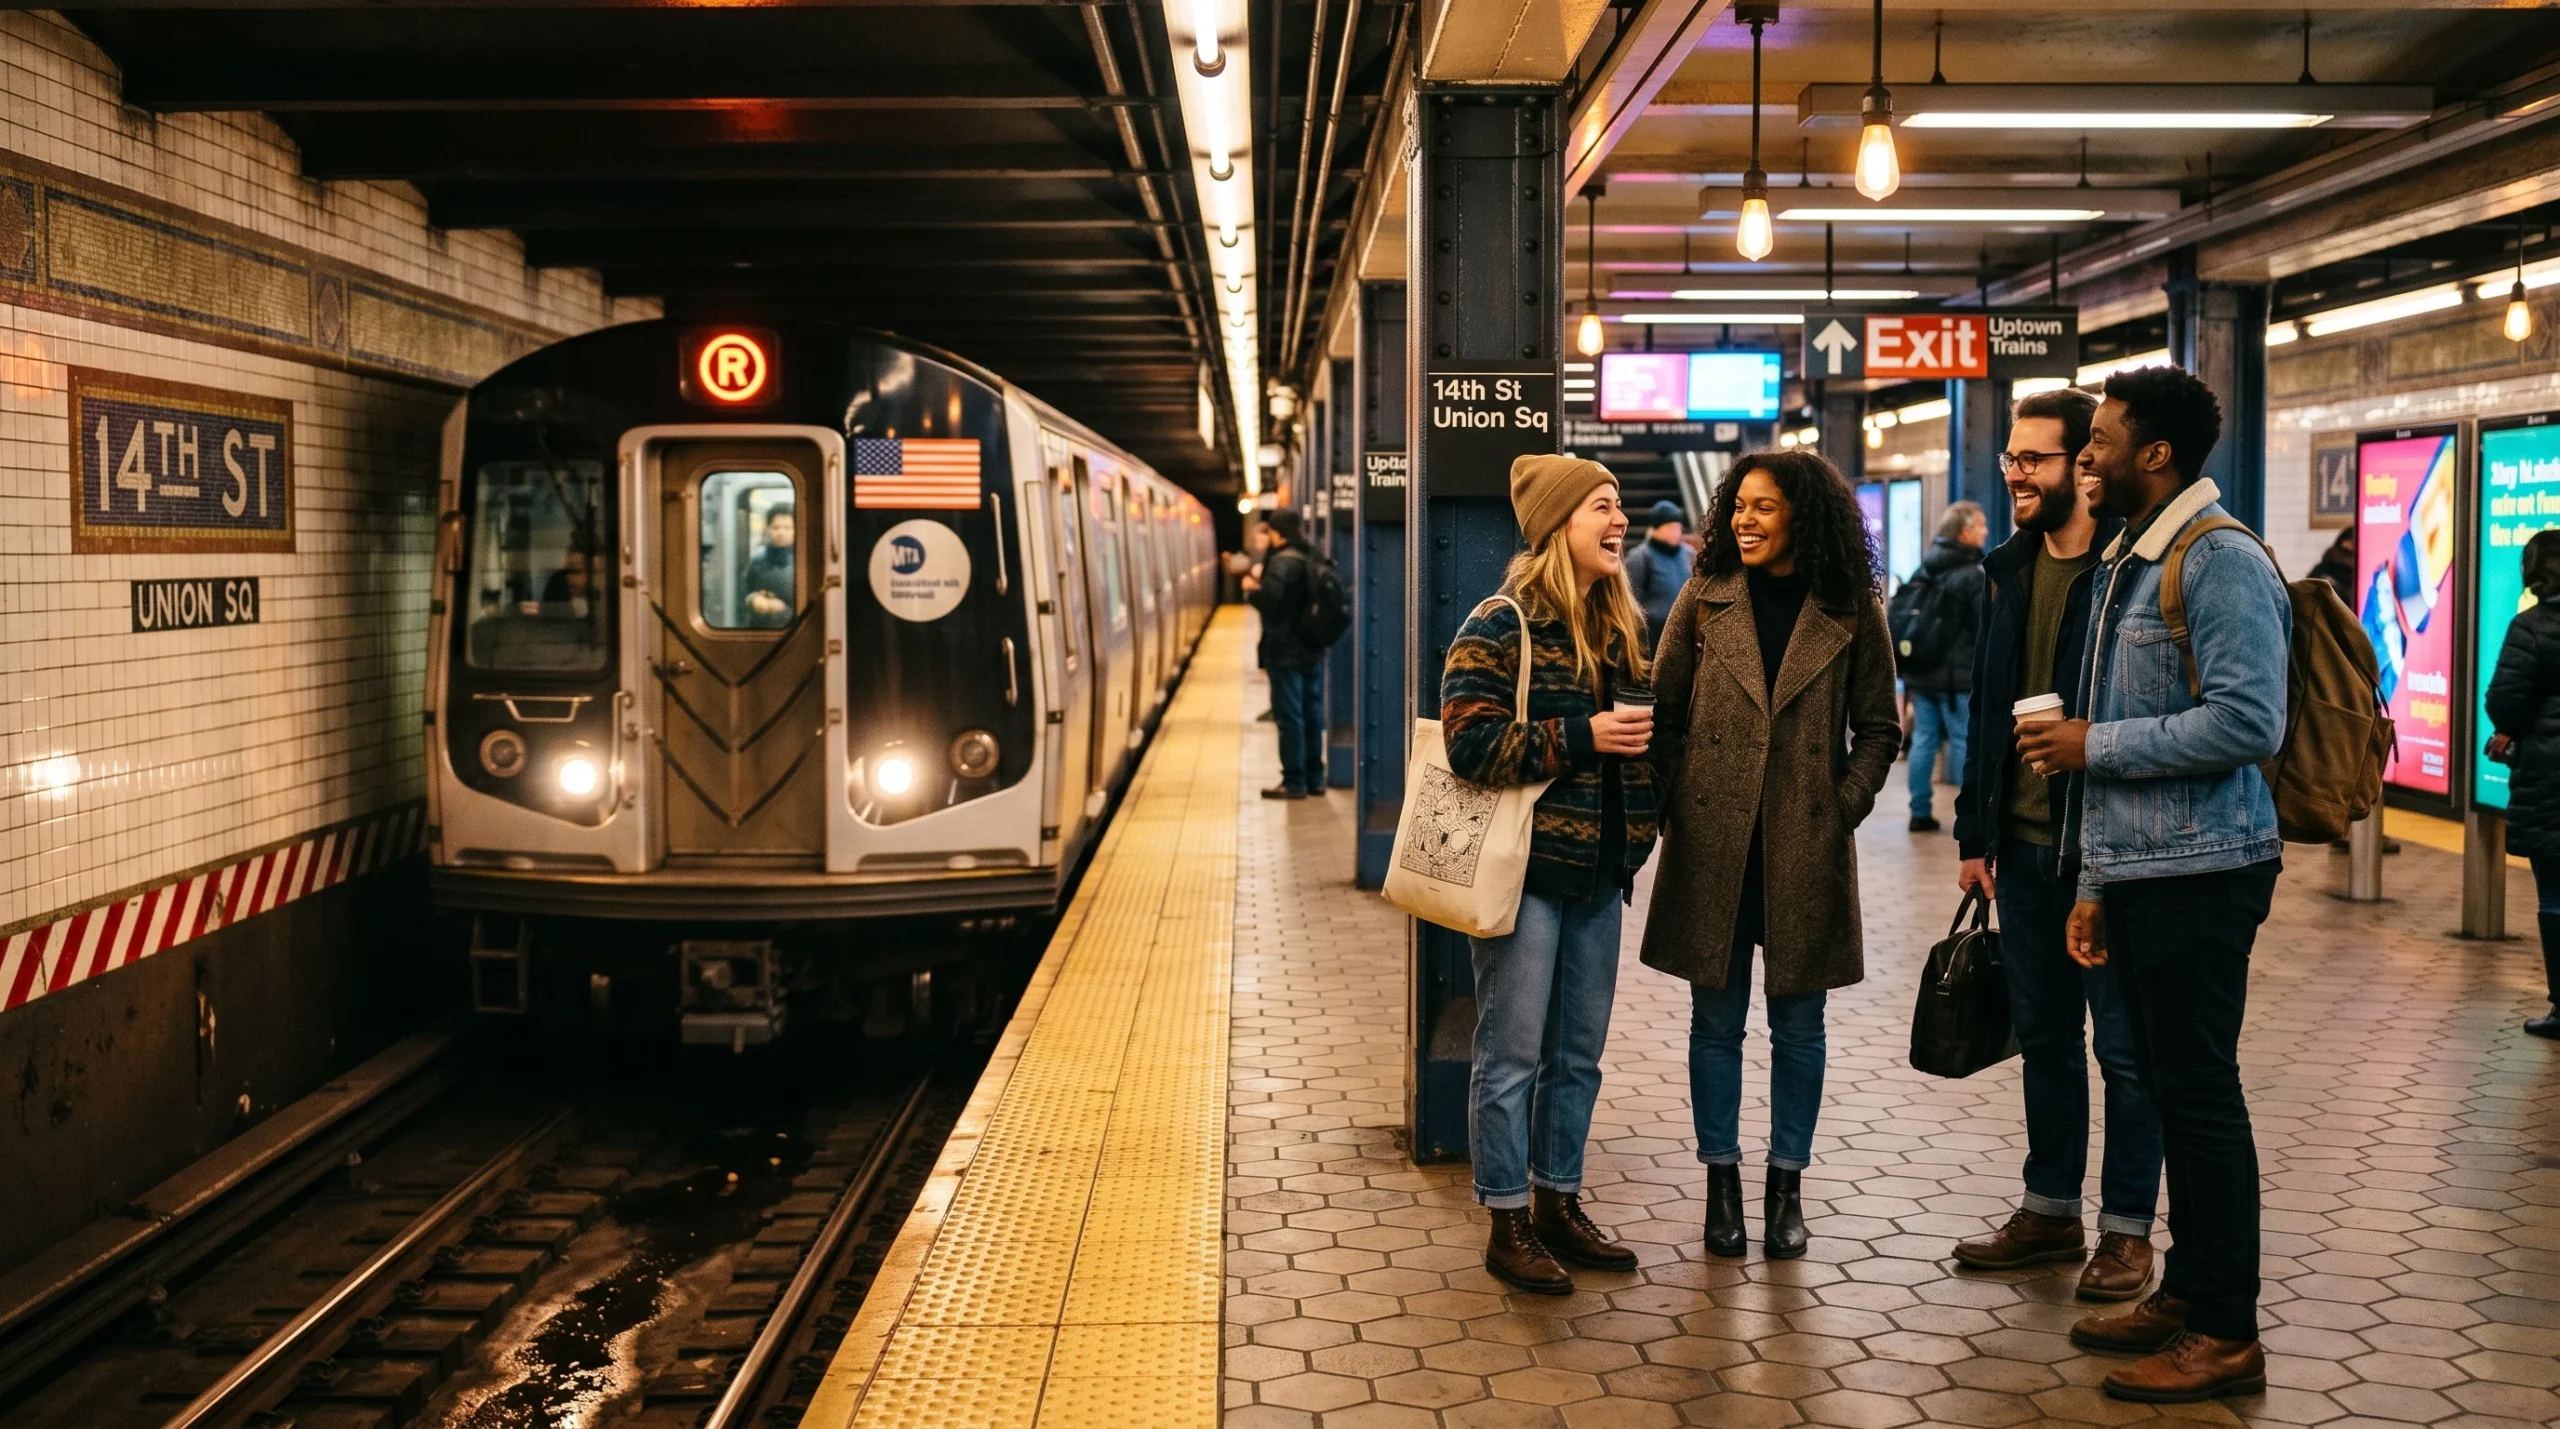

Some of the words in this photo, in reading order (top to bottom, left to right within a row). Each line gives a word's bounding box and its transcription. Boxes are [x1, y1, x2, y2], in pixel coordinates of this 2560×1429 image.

[1866, 318, 1978, 368] Exit
[1988, 318, 2063, 336] Uptown
[1988, 336, 2048, 355] Trains
[717, 346, 749, 387] R
[1433, 379, 1486, 401] 14th
[1494, 379, 1522, 401] St
[1433, 406, 1505, 428] Union
[1514, 406, 1548, 433] Sq
[95, 415, 199, 512] 14TH
[222, 428, 276, 518] ST
[138, 582, 213, 628] UNION
[224, 580, 254, 622] SQ
